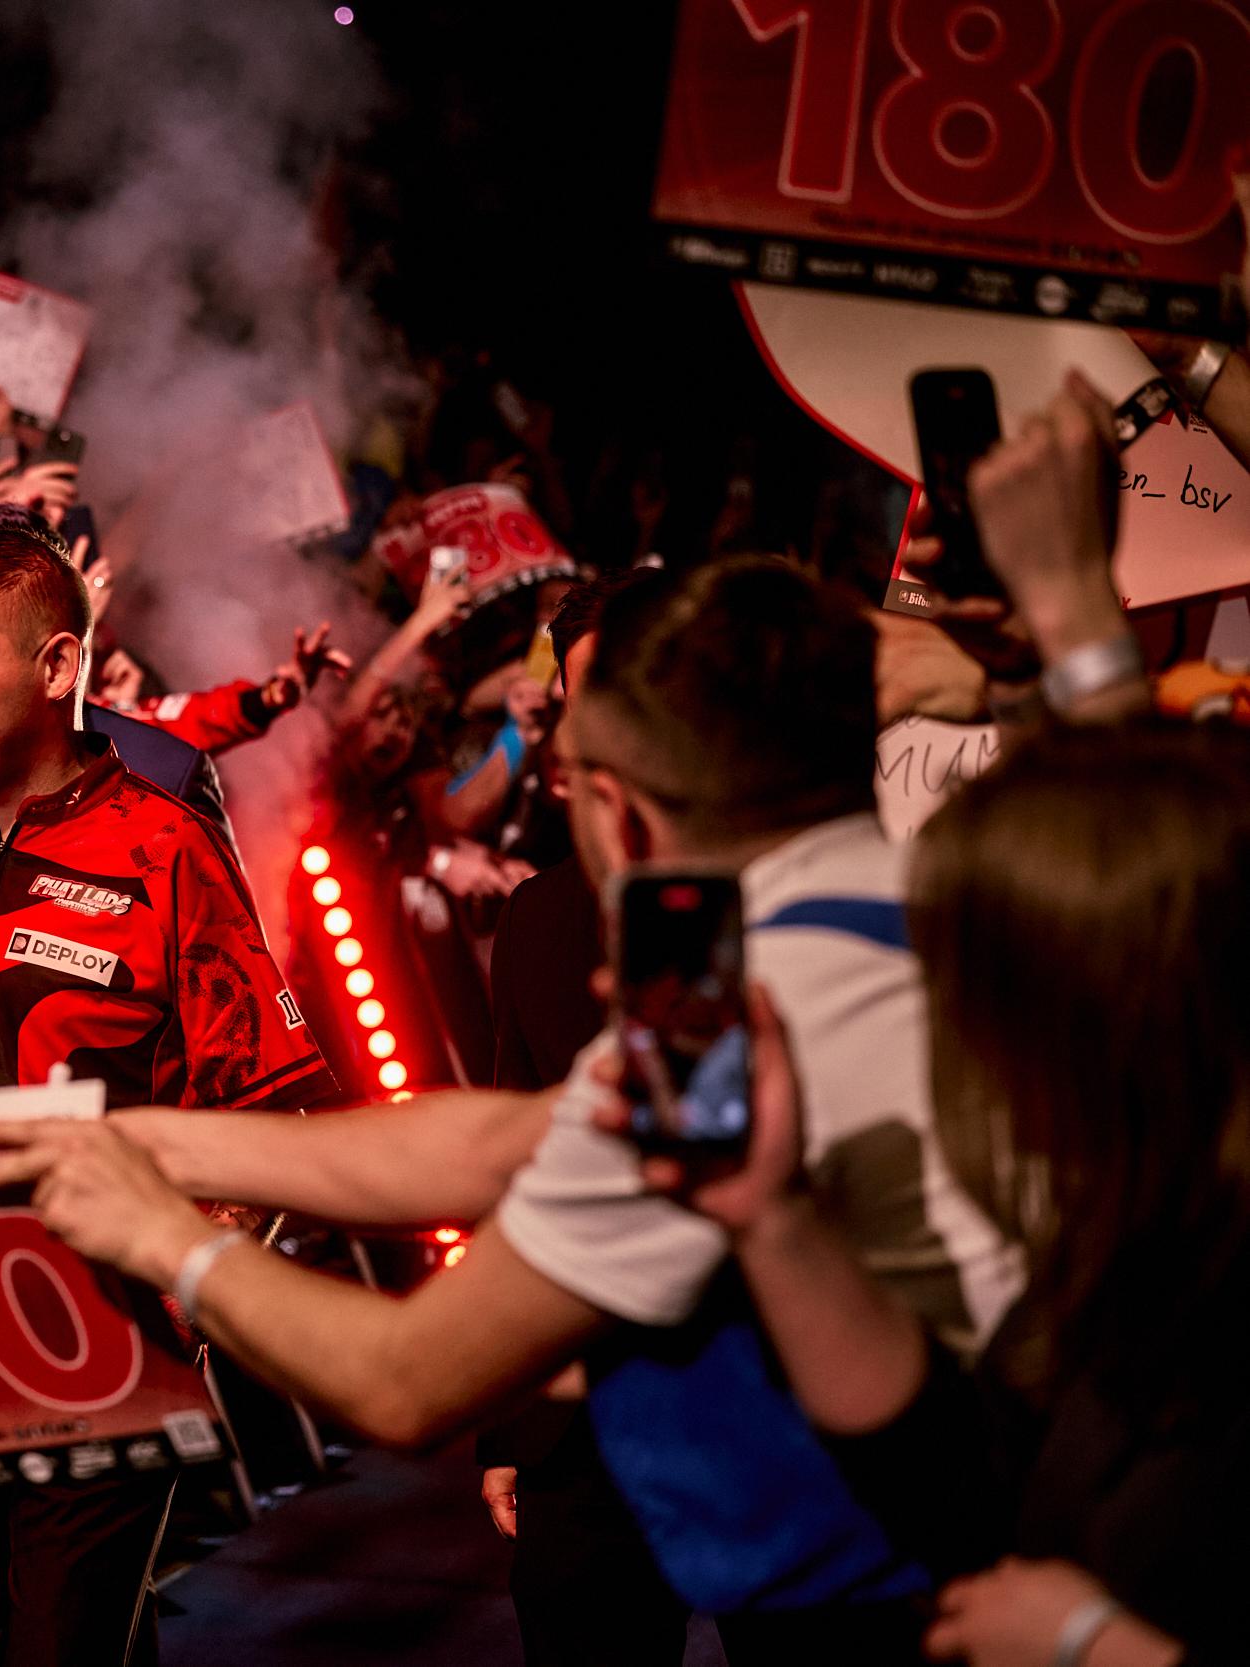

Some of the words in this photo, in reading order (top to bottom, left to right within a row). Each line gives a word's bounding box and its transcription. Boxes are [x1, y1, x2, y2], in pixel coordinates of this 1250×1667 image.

[731, 0, 1249, 244] 180
[31, 876, 84, 900] PHAT
[79, 887, 132, 915] LADS
[32, 939, 112, 974] DEPLOY
